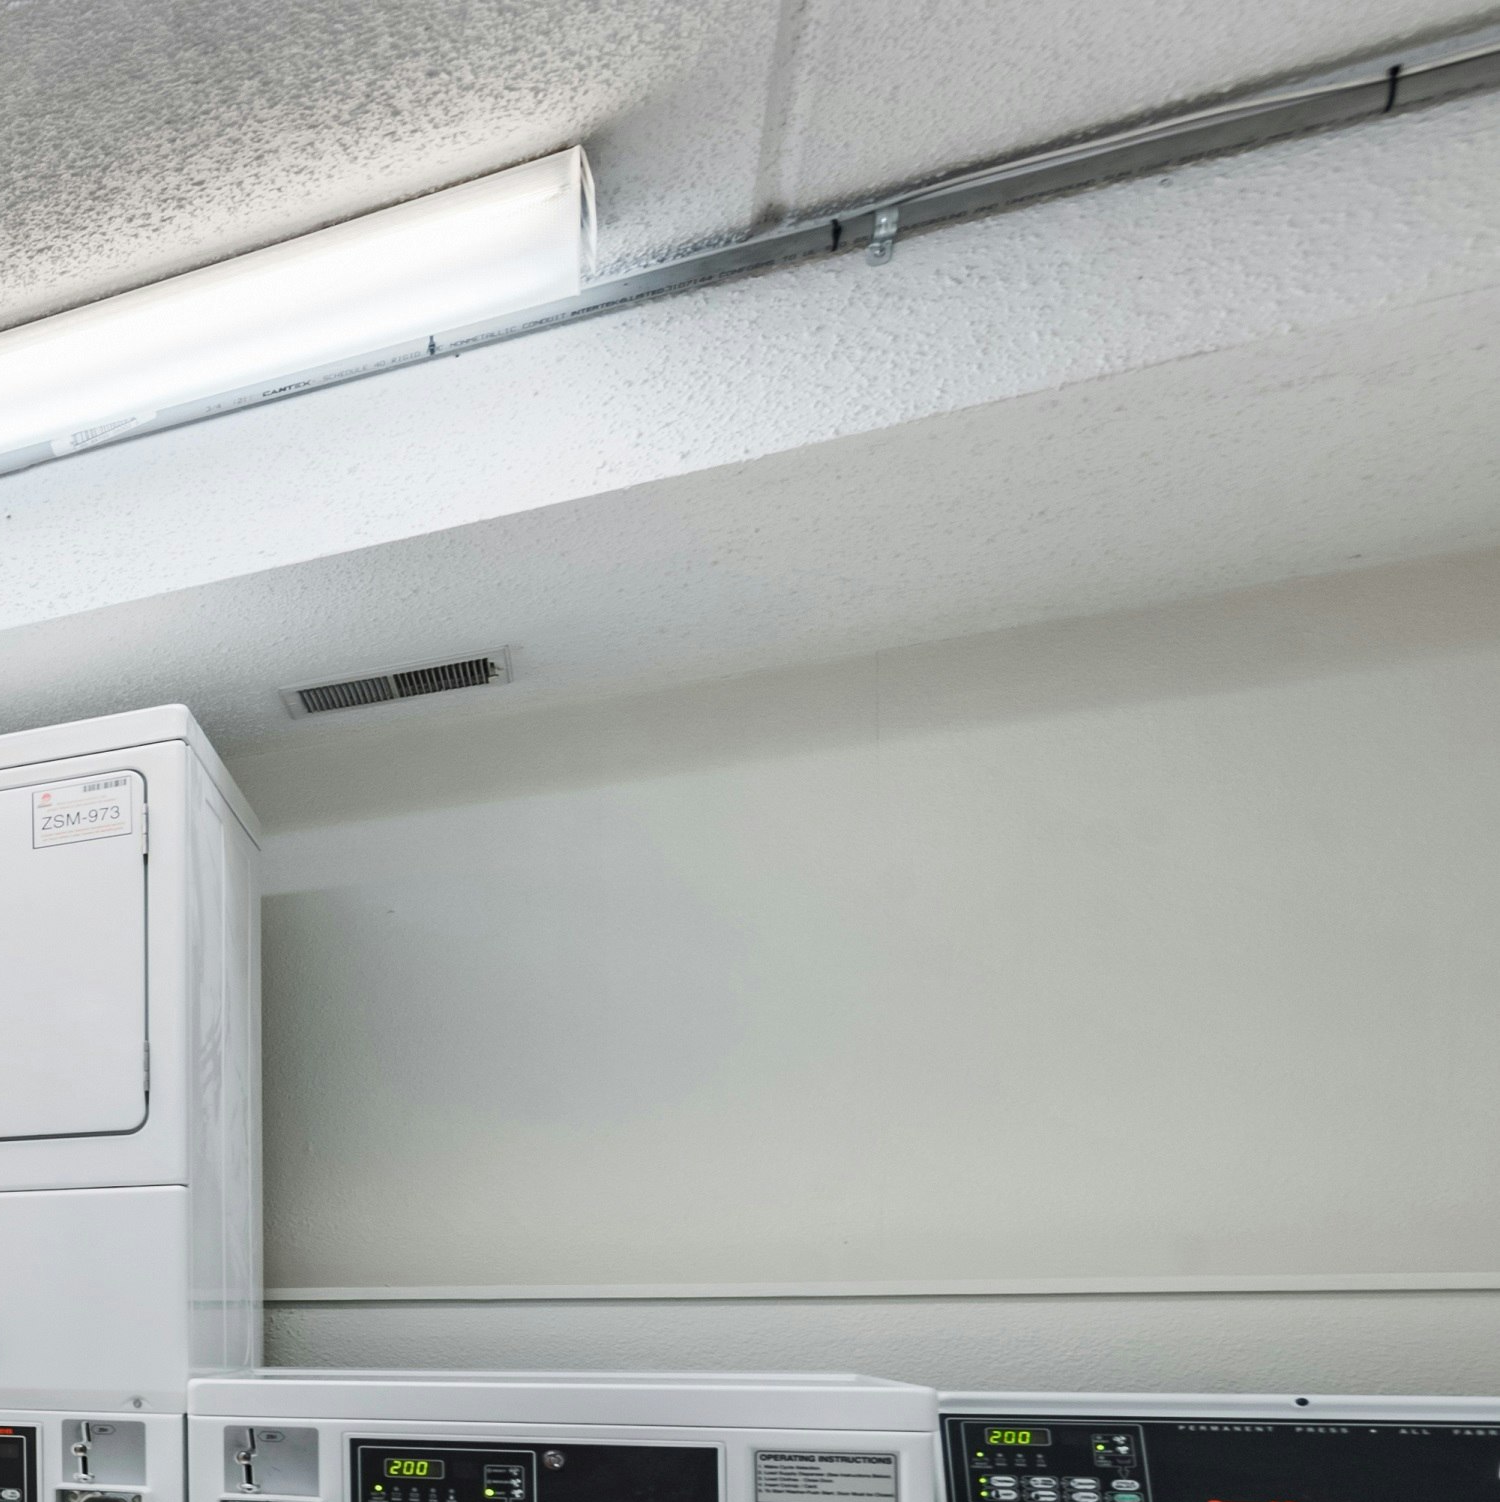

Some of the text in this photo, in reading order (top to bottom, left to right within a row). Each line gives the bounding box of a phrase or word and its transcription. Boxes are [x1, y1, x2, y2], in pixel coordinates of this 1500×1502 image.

[41, 805, 121, 831] ZSM-973
[989, 1430, 1031, 1444] 200
[759, 1453, 893, 1465] OPERATING INSTRUCTIONS
[389, 1460, 429, 1476] 200
